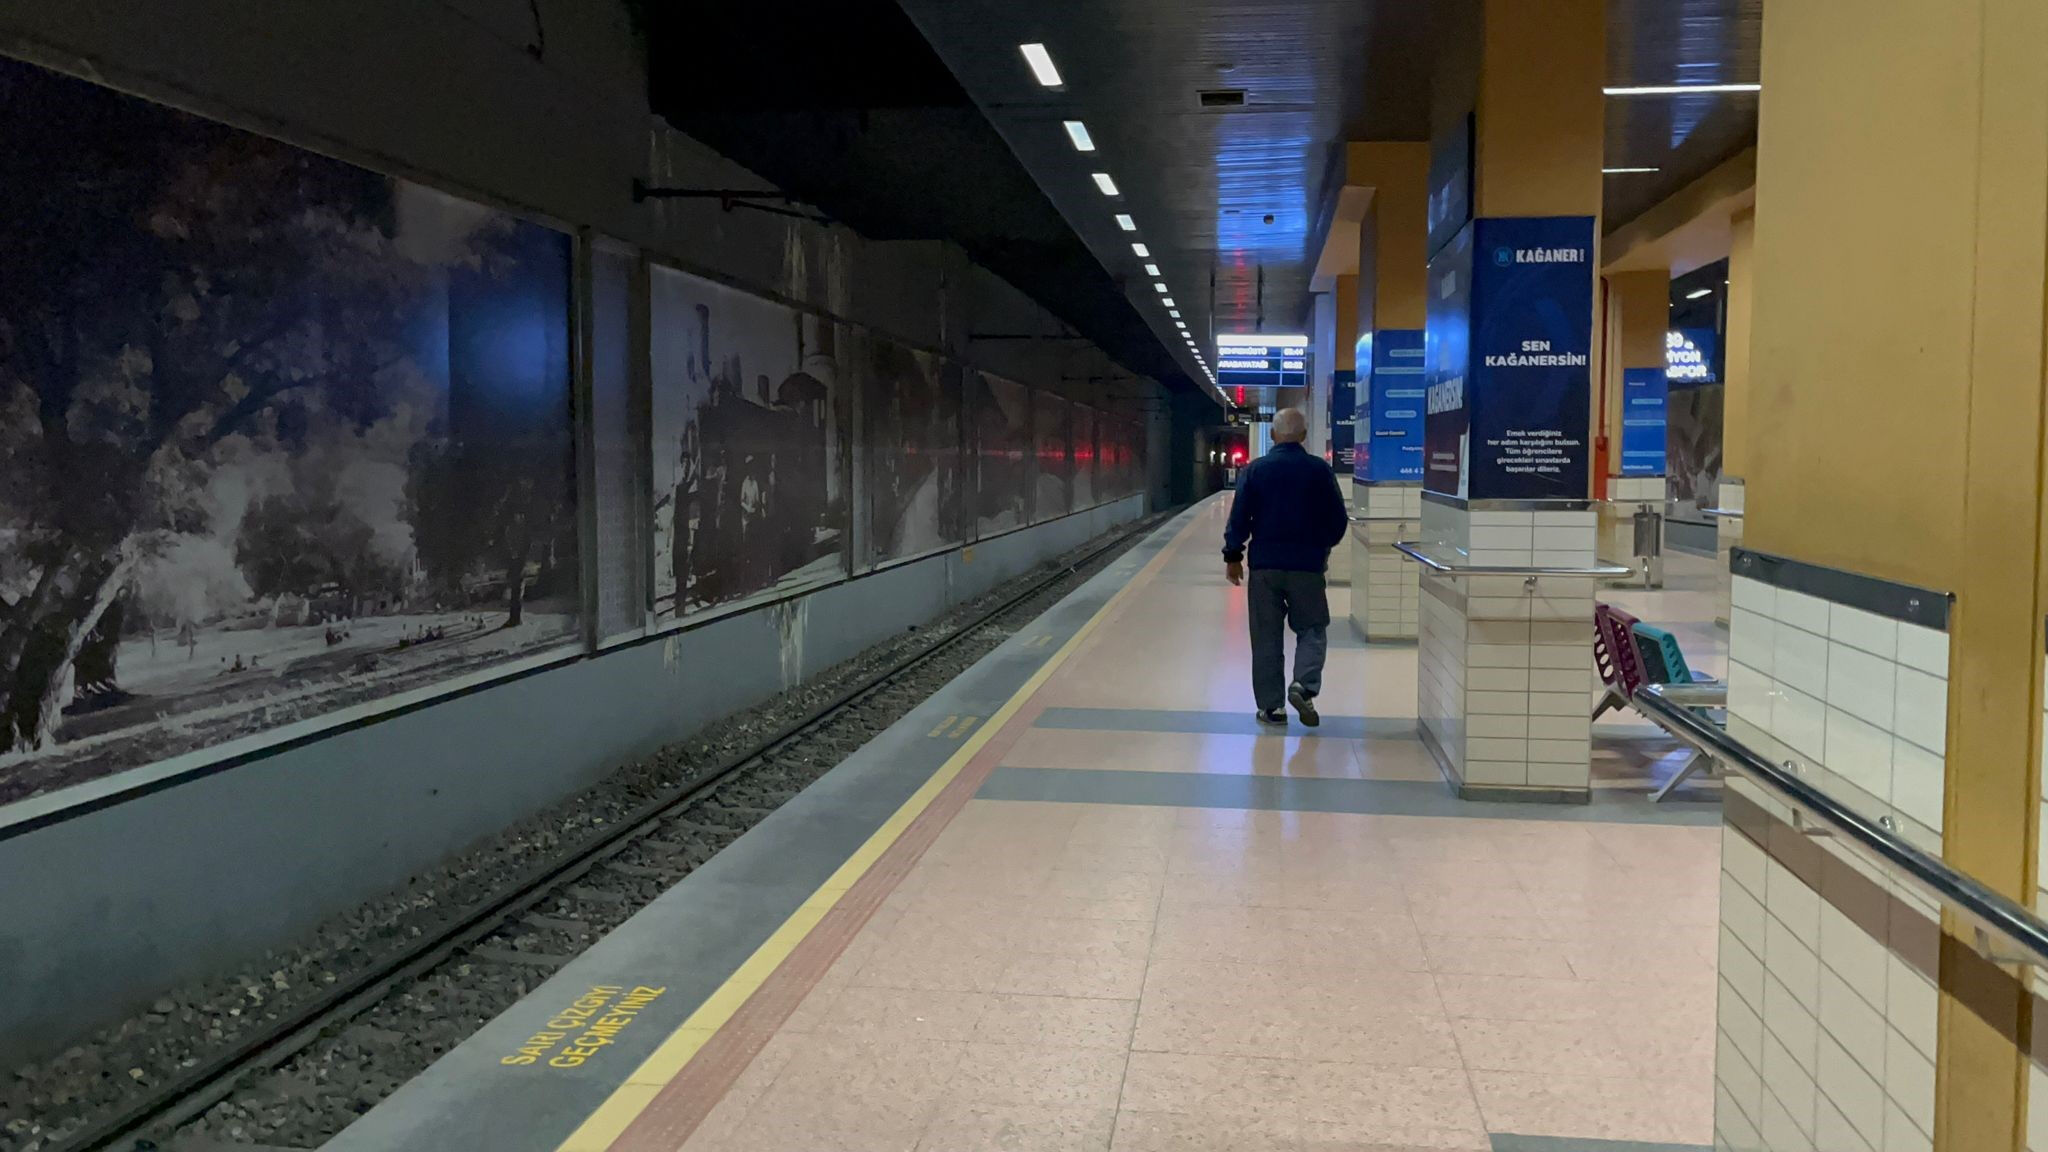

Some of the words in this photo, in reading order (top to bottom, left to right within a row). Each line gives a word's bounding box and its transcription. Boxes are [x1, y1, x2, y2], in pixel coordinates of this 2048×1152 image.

[1515, 246, 1579, 263] KAĞANER
[1521, 340, 1551, 352] SEN
[1485, 351, 1587, 367] KAĞANERSİN!
[1506, 429, 1526, 437] Emek
[1527, 429, 1562, 438] verdiğiniz
[1504, 447, 1521, 455] Tüm
[1521, 447, 1563, 456] öğrencilere
[548, 984, 667, 1068] GEÇMEYİNİZ
[501, 1031, 567, 1065] SARI
